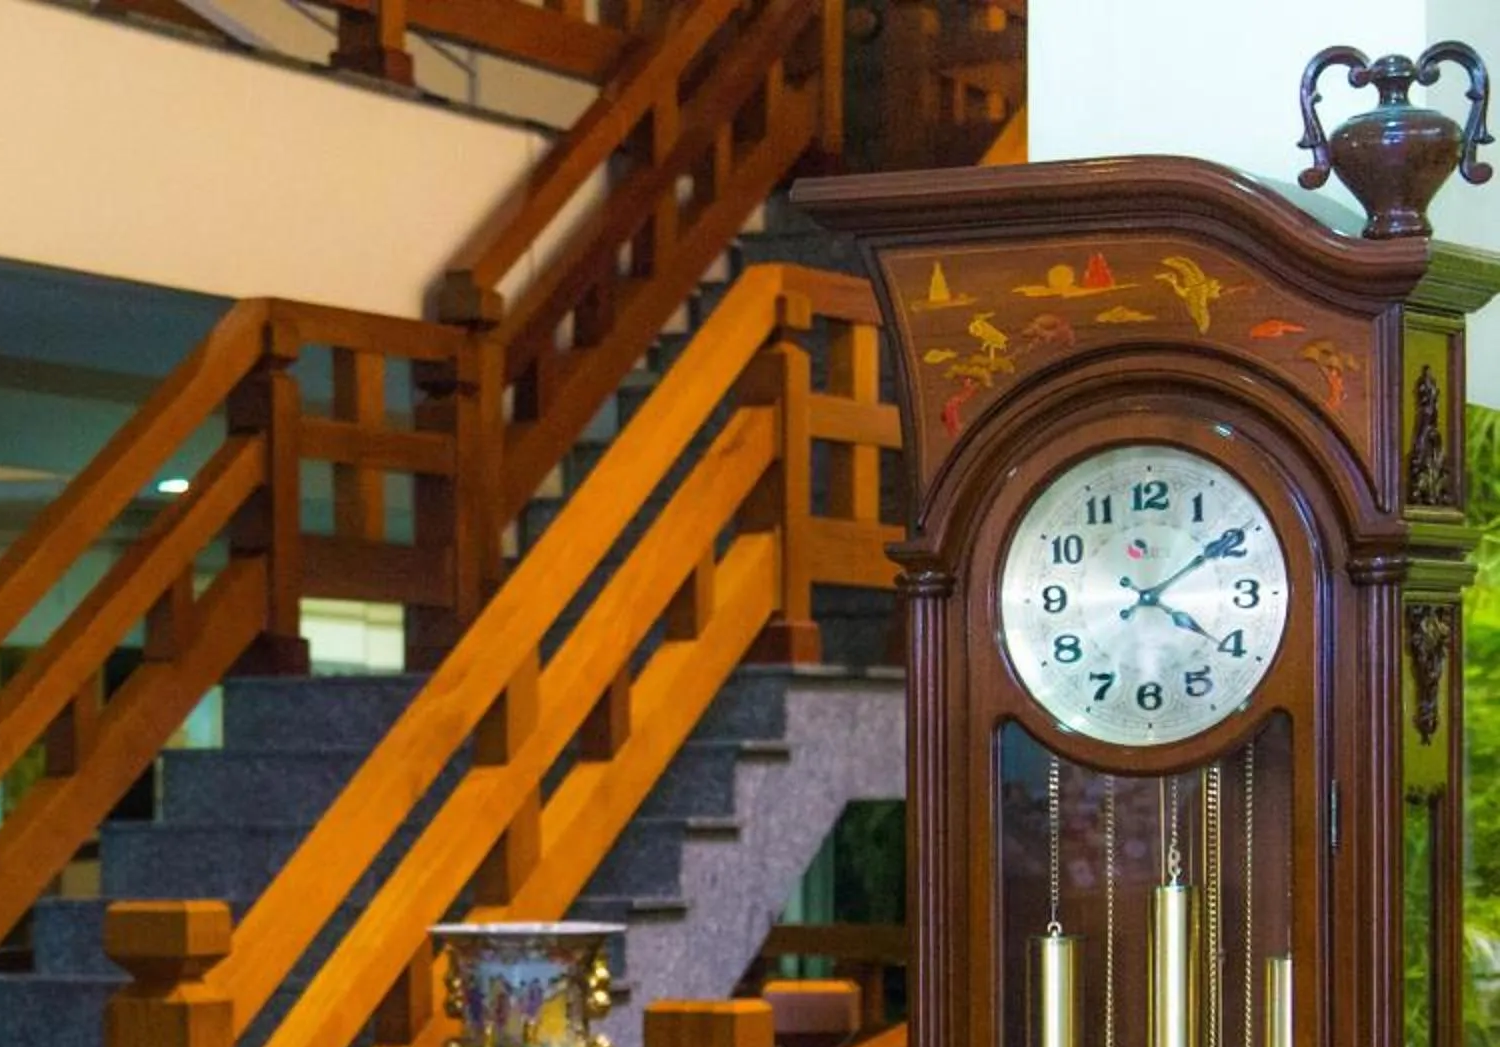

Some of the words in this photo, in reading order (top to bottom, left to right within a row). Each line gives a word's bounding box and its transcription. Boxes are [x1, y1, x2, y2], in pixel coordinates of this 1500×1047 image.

[1086, 495, 1112, 524] 11
[1130, 480, 1169, 510] 12
[1192, 493, 1204, 522] 1
[1051, 534, 1083, 564] 10
[1219, 528, 1247, 558] 2
[1041, 585, 1067, 614] 9
[1233, 579, 1260, 608] 3
[1053, 634, 1082, 663] 8
[1217, 629, 1247, 658] 4
[1089, 672, 1114, 701] 7
[1185, 665, 1213, 696] 5
[1136, 682, 1163, 710] 6
